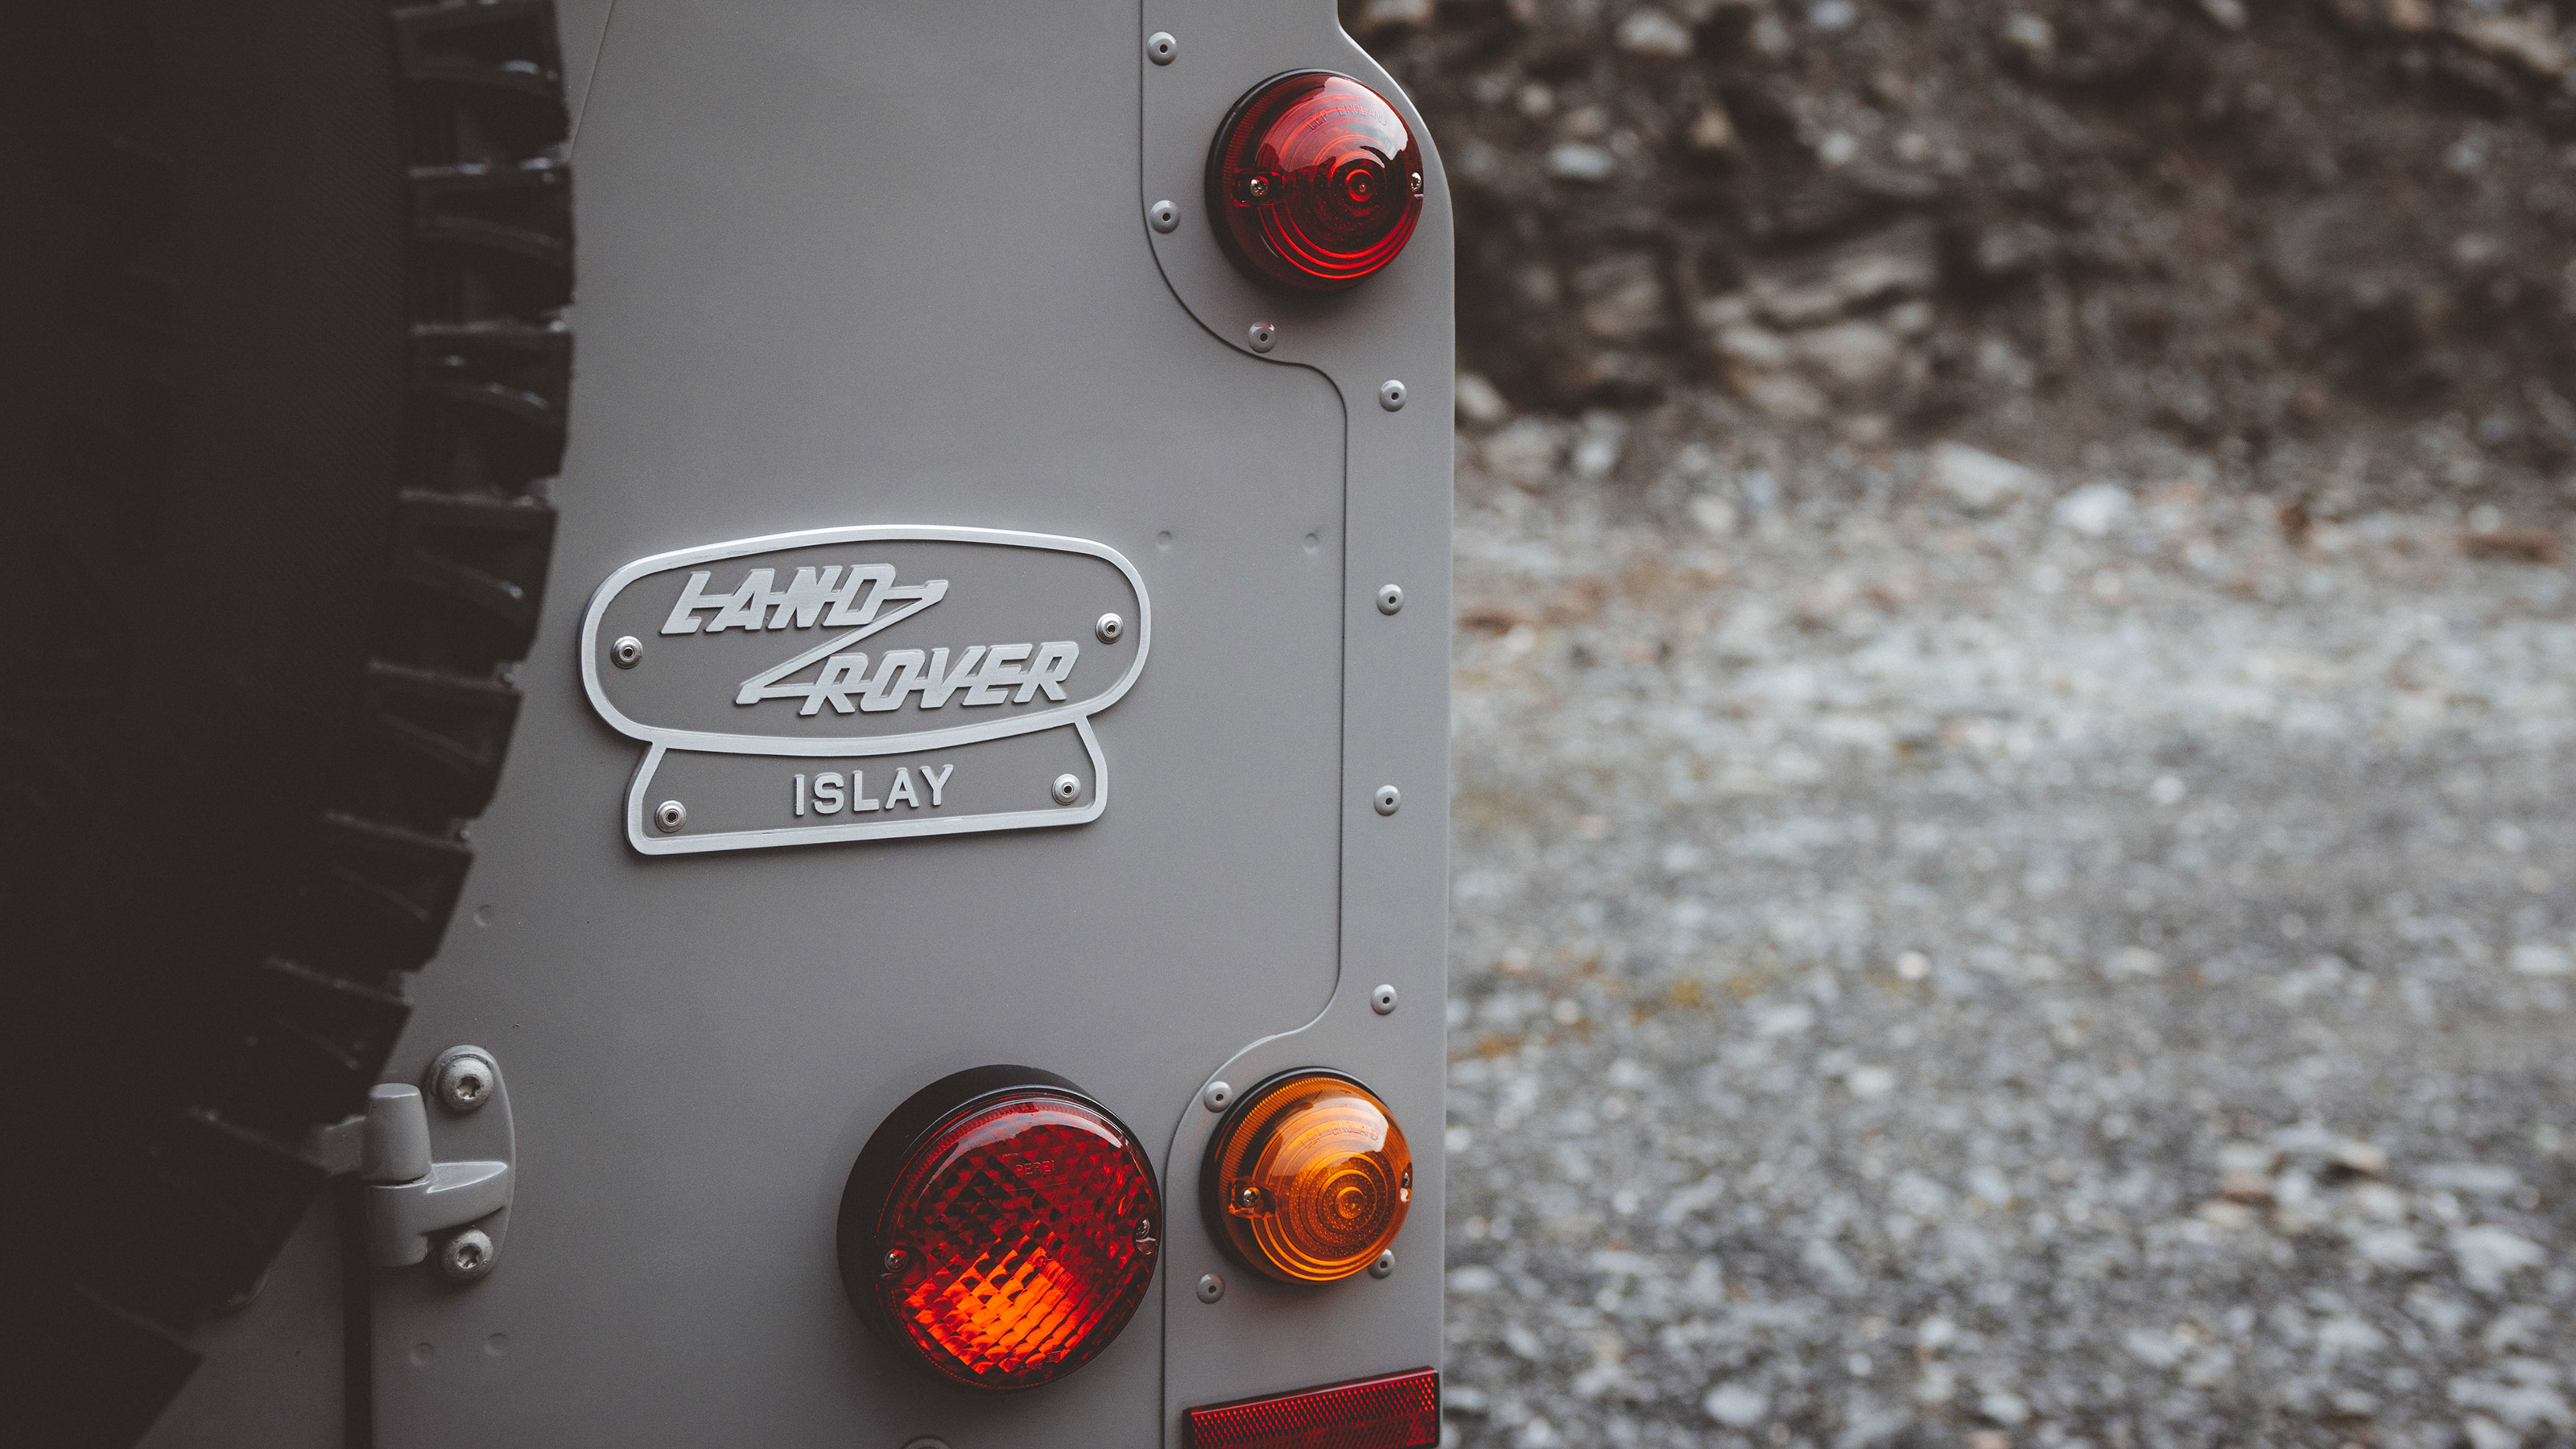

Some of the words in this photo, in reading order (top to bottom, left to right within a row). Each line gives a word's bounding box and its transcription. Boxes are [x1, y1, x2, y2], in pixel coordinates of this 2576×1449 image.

[1336, 104, 1387, 126] ENGLAND
[661, 564, 898, 634] LAND
[799, 641, 1080, 715] ROVER
[793, 764, 955, 815] ISLAY
[1331, 1121, 1379, 1141] ENGLAND
